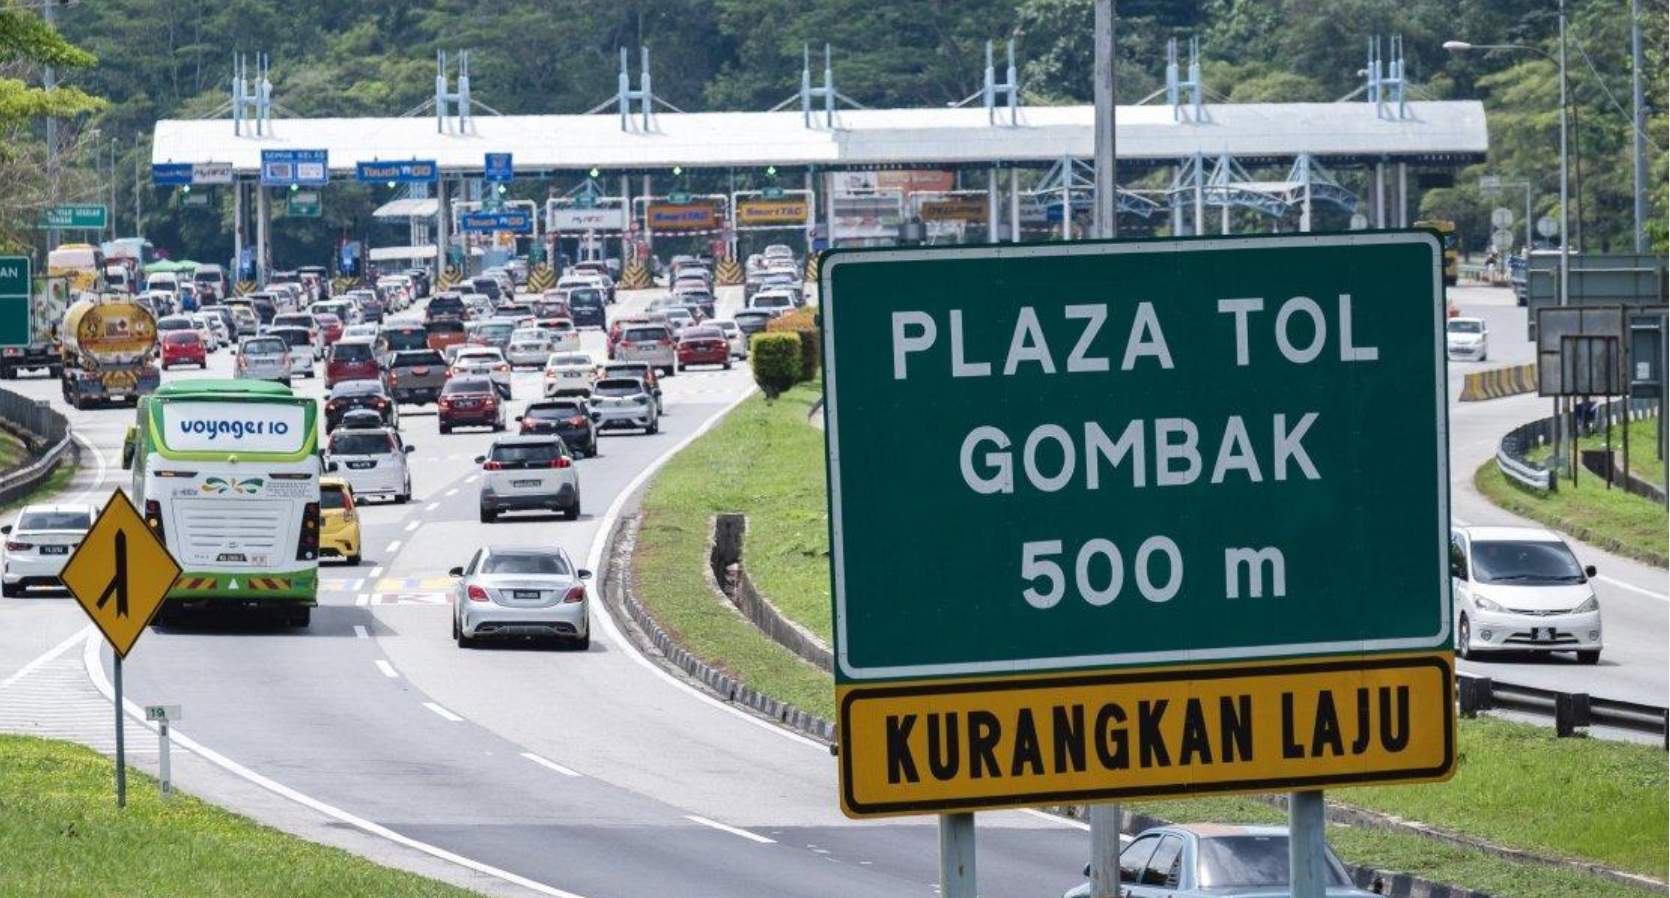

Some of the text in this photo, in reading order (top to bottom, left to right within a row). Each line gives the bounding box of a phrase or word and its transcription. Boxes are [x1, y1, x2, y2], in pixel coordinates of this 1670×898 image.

[363, 165, 401, 178] Touch
[892, 294, 1379, 379] PLAZA TOL
[180, 420, 264, 440] voyager
[960, 412, 1321, 494] GOMBAK
[1021, 535, 1286, 609] 500 m
[886, 685, 1410, 785] KURANGKAN LAJU
